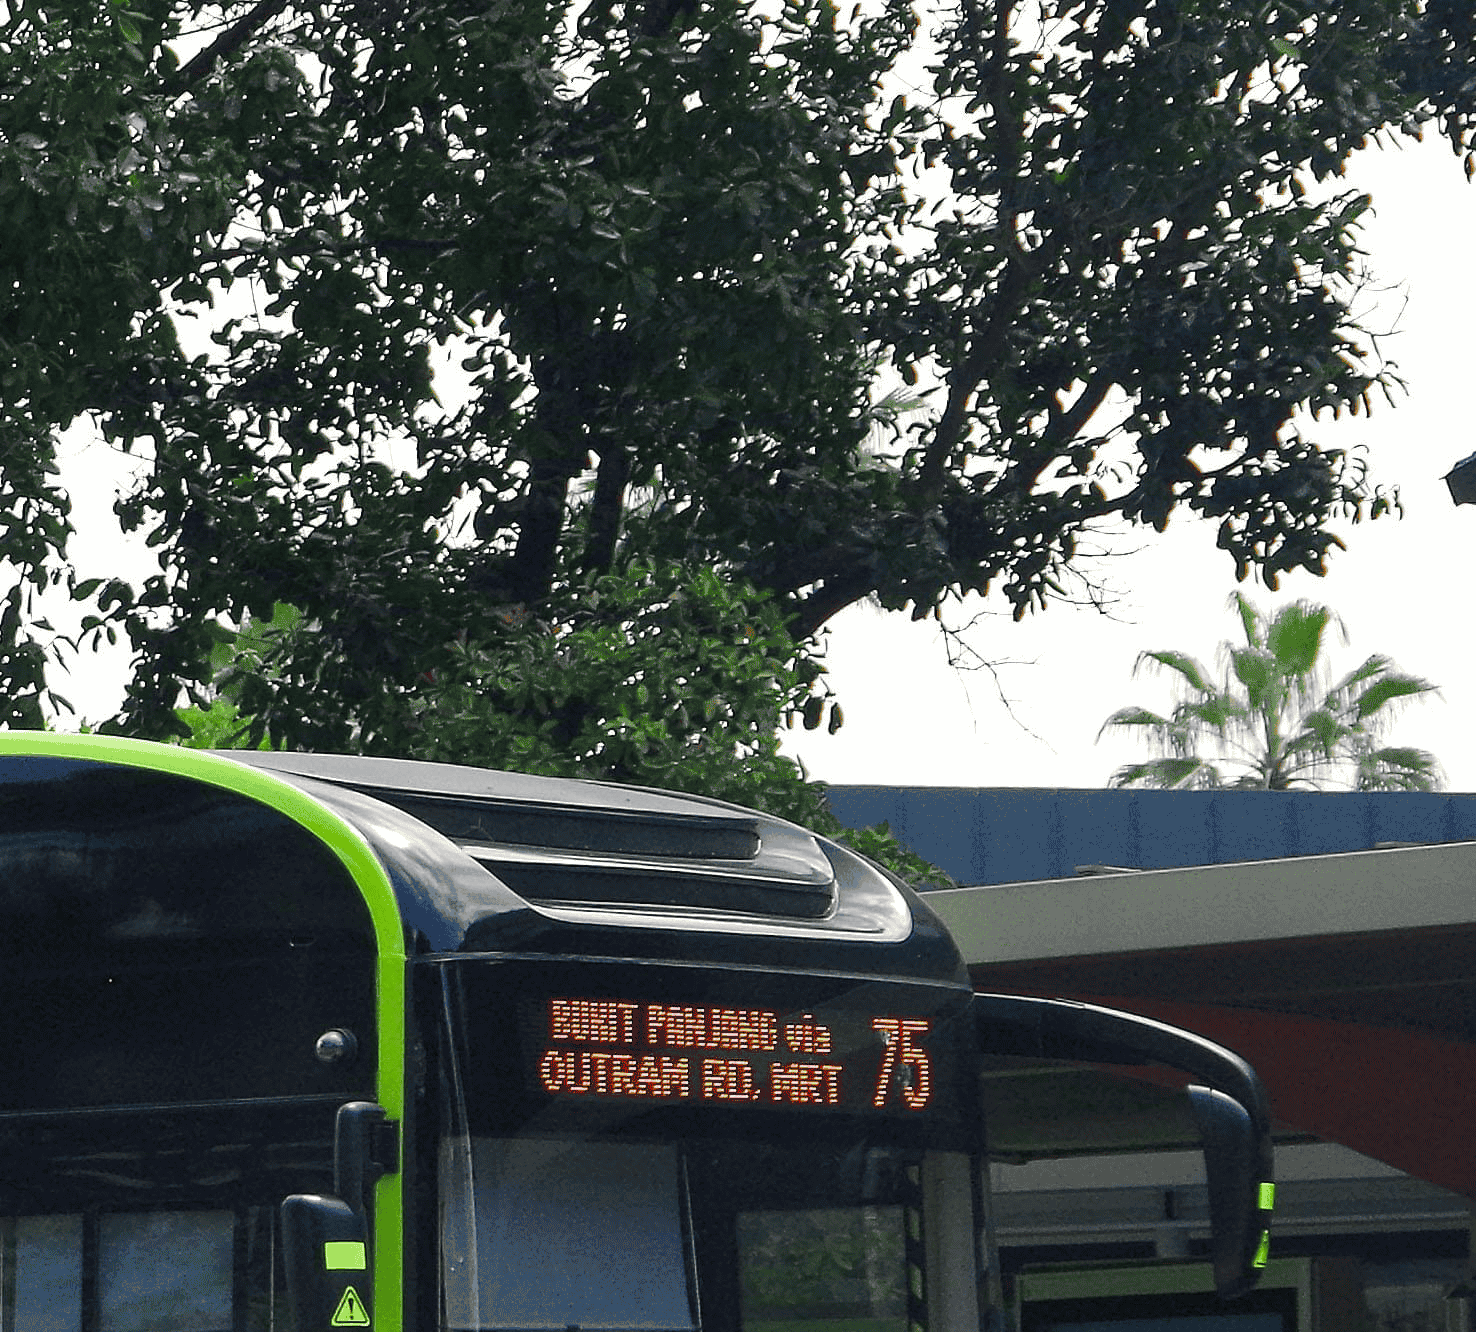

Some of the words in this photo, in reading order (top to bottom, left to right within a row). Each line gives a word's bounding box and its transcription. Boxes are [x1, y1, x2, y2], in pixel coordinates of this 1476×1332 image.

[551, 1000, 638, 1043] BUKIT
[647, 1005, 778, 1050] PANJANG
[786, 1012, 831, 1053] via
[540, 1050, 689, 1096] OUTRAM
[702, 1059, 760, 1100] RD.
[771, 1061, 842, 1103] MRT
[871, 1017, 929, 1107] 75
